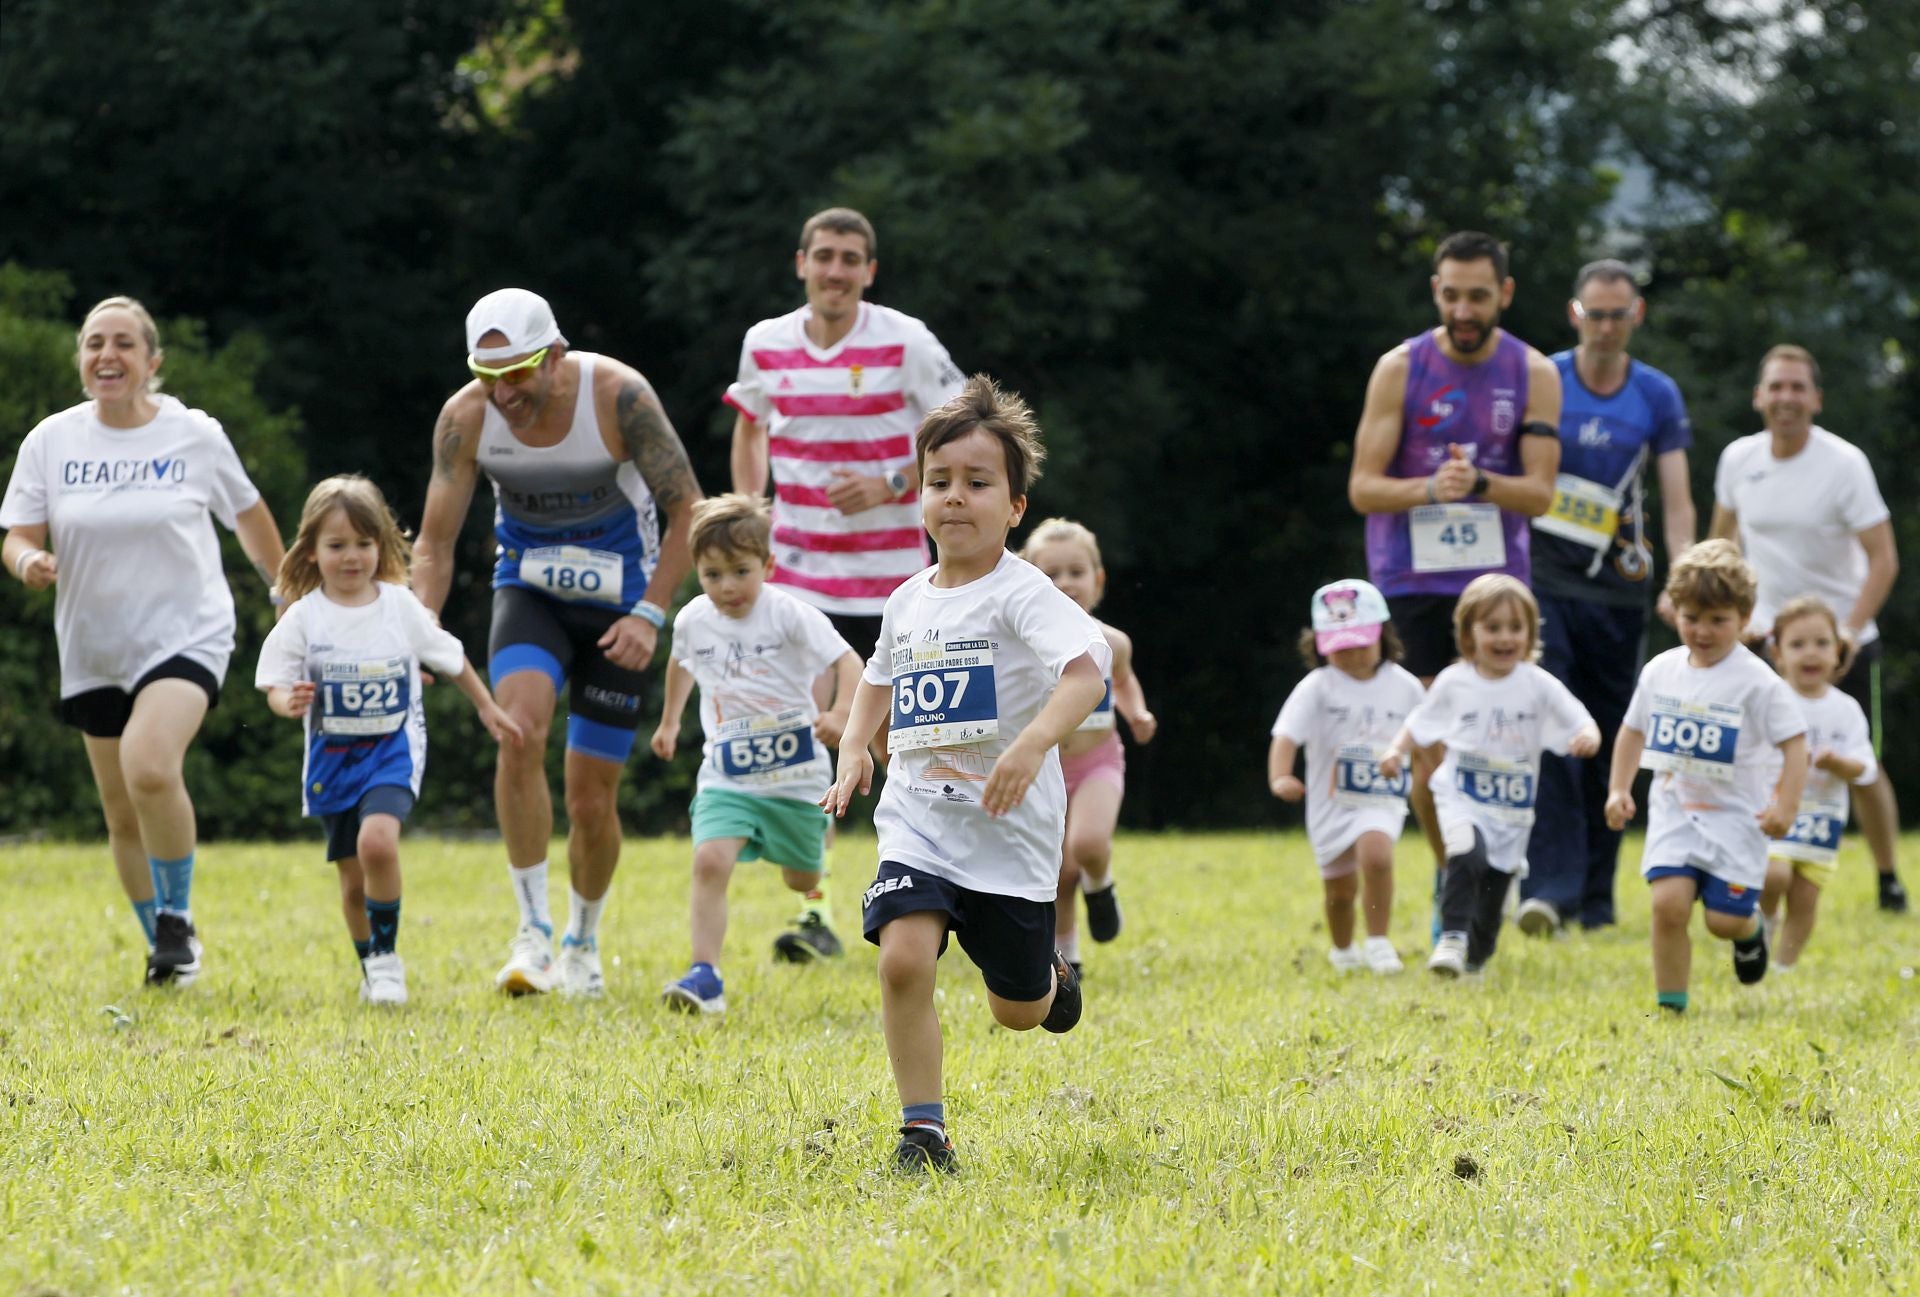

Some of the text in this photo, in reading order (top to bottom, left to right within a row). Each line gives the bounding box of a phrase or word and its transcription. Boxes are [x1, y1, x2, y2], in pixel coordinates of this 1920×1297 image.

[64, 457, 186, 485] CEACTIVO
[1439, 523, 1479, 545] 45
[542, 565, 602, 593] 180
[915, 662, 920, 670] LA
[921, 659, 945, 670] FACULTAD
[946, 658, 964, 667] PADRE
[341, 679, 399, 712] 522
[898, 671, 971, 715] 507
[915, 712, 946, 724] BRUNO
[1657, 715, 1723, 754] 508
[730, 732, 799, 769] 530
[1474, 768, 1528, 803] 516
